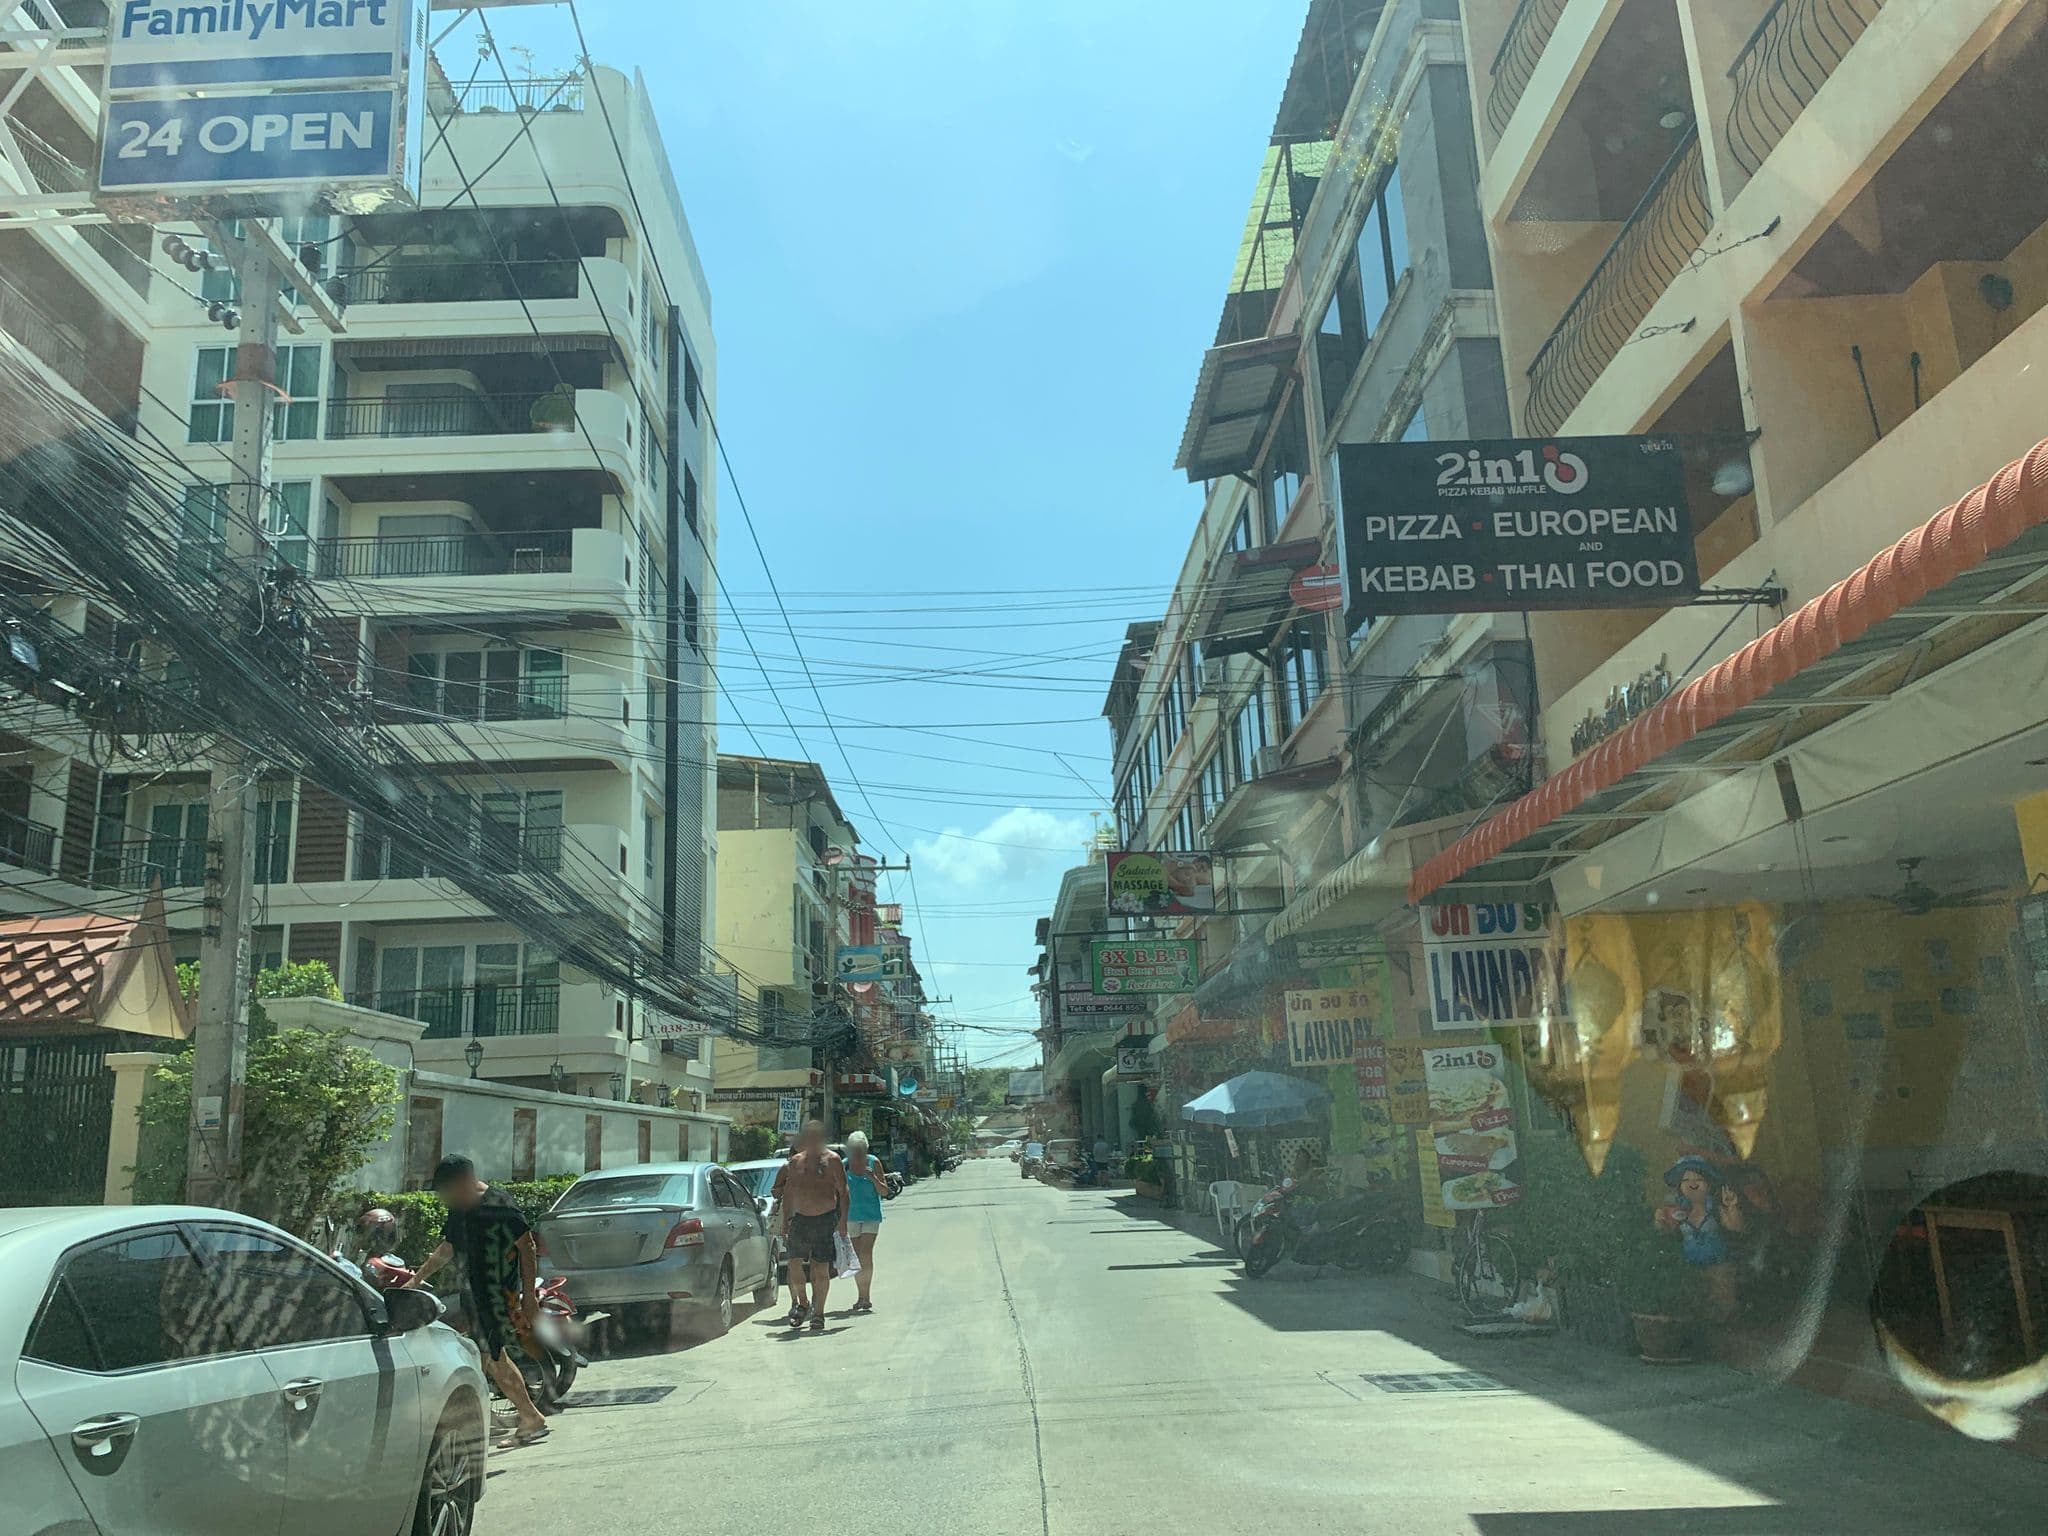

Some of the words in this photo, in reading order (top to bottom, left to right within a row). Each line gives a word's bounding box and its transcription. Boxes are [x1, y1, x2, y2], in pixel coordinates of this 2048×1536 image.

[122, 0, 387, 40] FamilyMart
[118, 118, 183, 159] 24
[198, 111, 374, 154] OPEN
[1435, 448, 1541, 486] 2in1
[1438, 487, 1468, 497] PIZZA
[1469, 486, 1505, 497] KEBAB
[1506, 484, 1547, 496] WAFFLE
[1366, 513, 1463, 541] PIZZA
[1493, 506, 1678, 538] EUROPEAN
[1579, 541, 1604, 552] AND
[1360, 563, 1476, 593] KEBAB
[1497, 561, 1576, 592] THAI
[1586, 559, 1684, 589] FOOD
[1113, 879, 1164, 891] MASSAGE
[1100, 949, 1128, 964] 3X
[1430, 948, 1569, 1023] LAUNDRY
[1355, 1046, 1384, 1059] BIKE
[1432, 1052, 1475, 1068] 2in1
[1359, 1066, 1383, 1078] FOR
[1358, 1085, 1386, 1098] RENT
[781, 1100, 801, 1110] RENT
[783, 1111, 797, 1120] FOR
[1476, 1114, 1509, 1127] Pizza
[779, 1121, 801, 1132] MONTH
[1440, 1157, 1487, 1168] European
